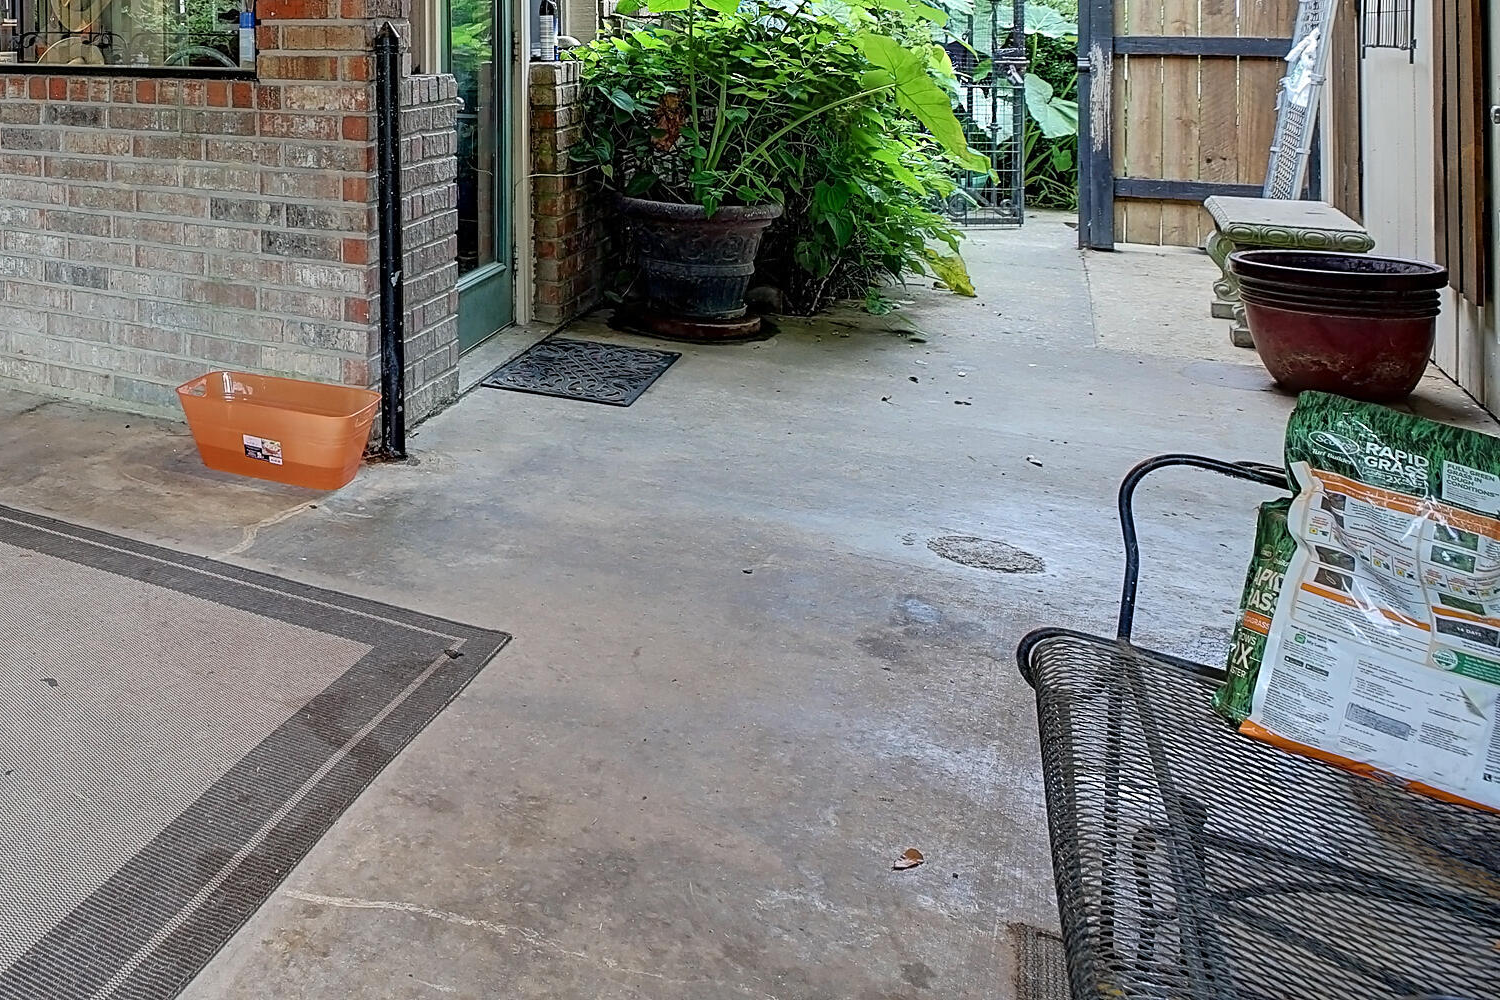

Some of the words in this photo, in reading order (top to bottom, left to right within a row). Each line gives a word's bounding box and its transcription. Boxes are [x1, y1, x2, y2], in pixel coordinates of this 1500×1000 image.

[1365, 441, 1429, 467] RAPID
[1364, 455, 1429, 481] GRASS
[1446, 468, 1473, 480] GRASS
[1469, 470, 1496, 482] GREEN
[1446, 473, 1474, 486] TOUGH
[1254, 566, 1285, 592] APID
